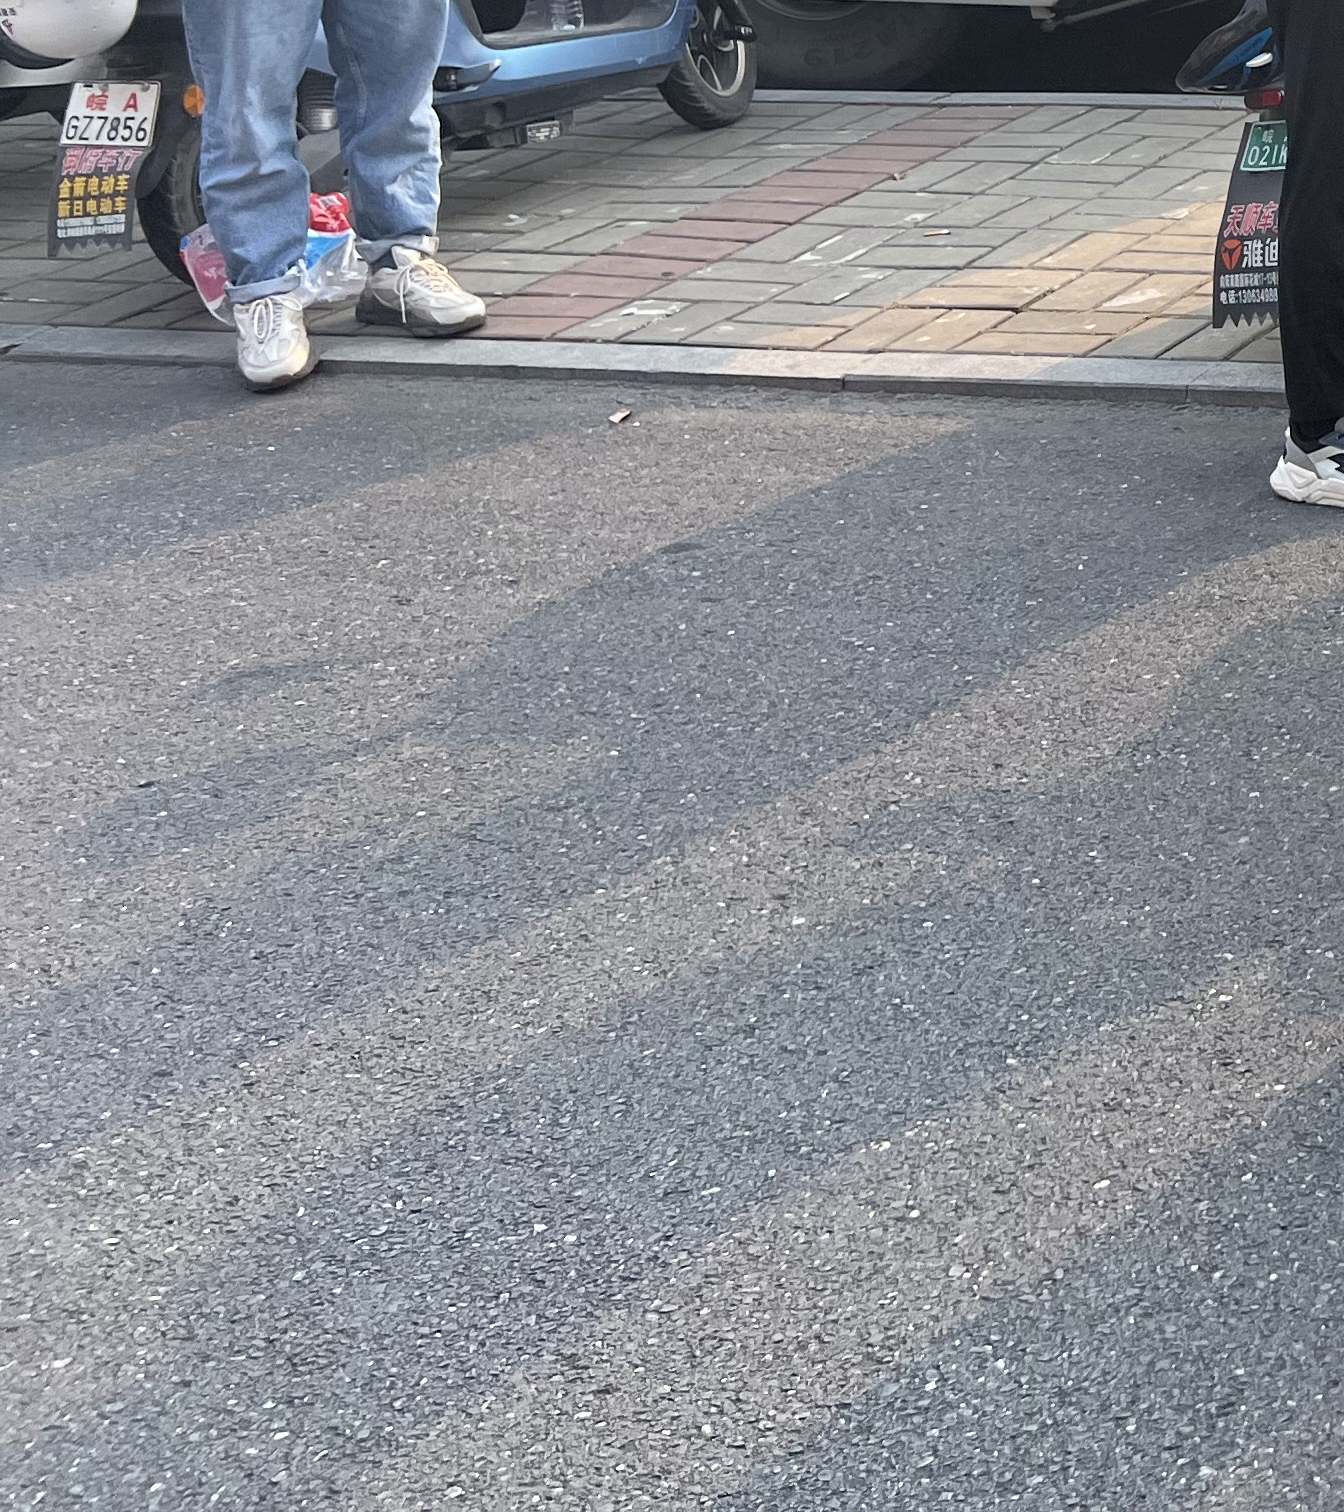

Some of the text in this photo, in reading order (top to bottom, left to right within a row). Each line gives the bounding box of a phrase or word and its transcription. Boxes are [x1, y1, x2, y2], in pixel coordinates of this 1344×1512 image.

[65, 115, 148, 142] GZ7856
[1223, 200, 1280, 238] 天顺车
